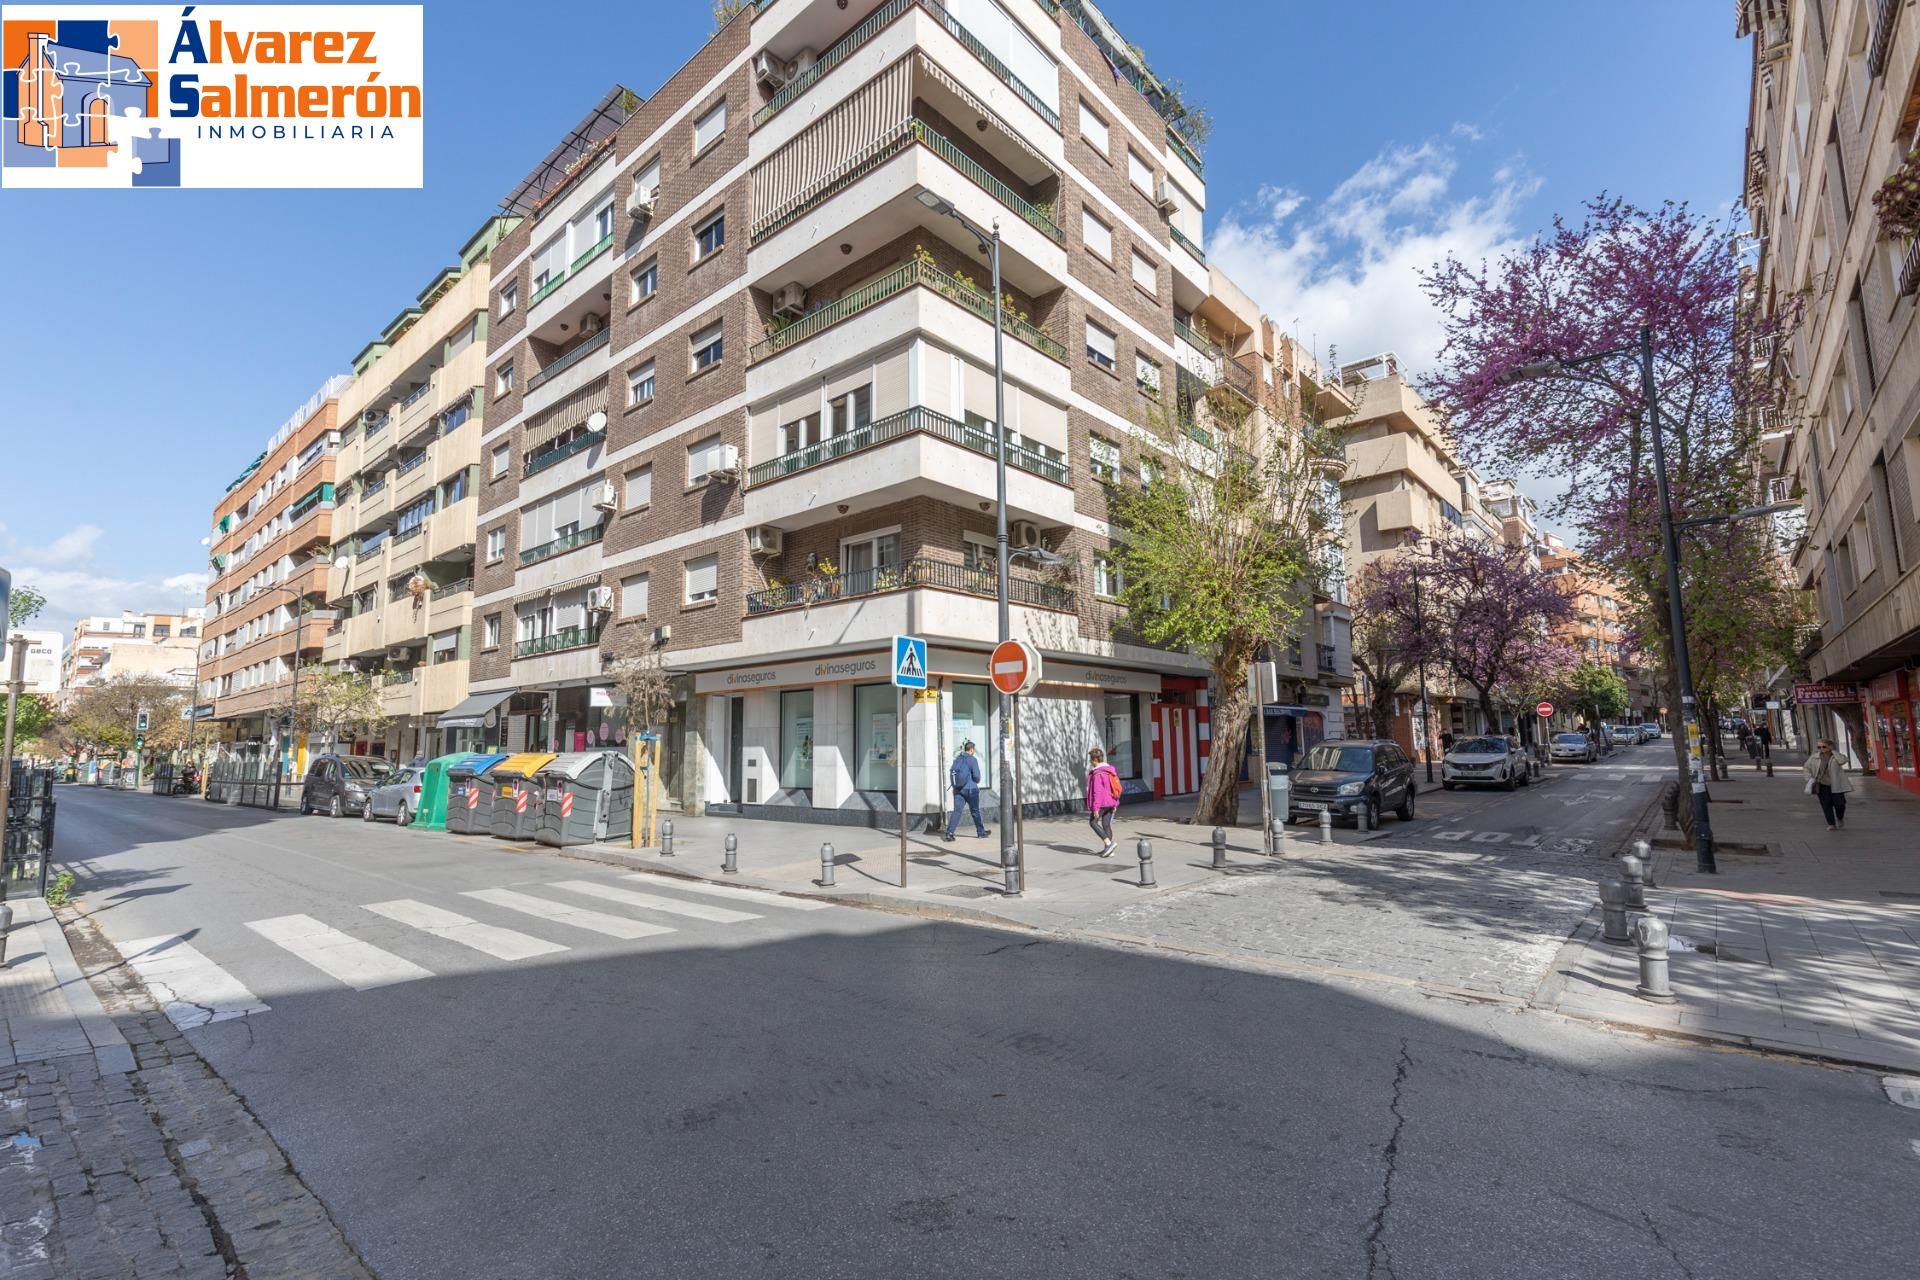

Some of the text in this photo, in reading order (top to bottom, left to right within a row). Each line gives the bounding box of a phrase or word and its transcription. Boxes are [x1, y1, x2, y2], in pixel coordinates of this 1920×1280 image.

[815, 660, 876, 676] divinaseguros
[726, 672, 776, 684] divinaseguros
[1796, 687, 1846, 698] Francis
